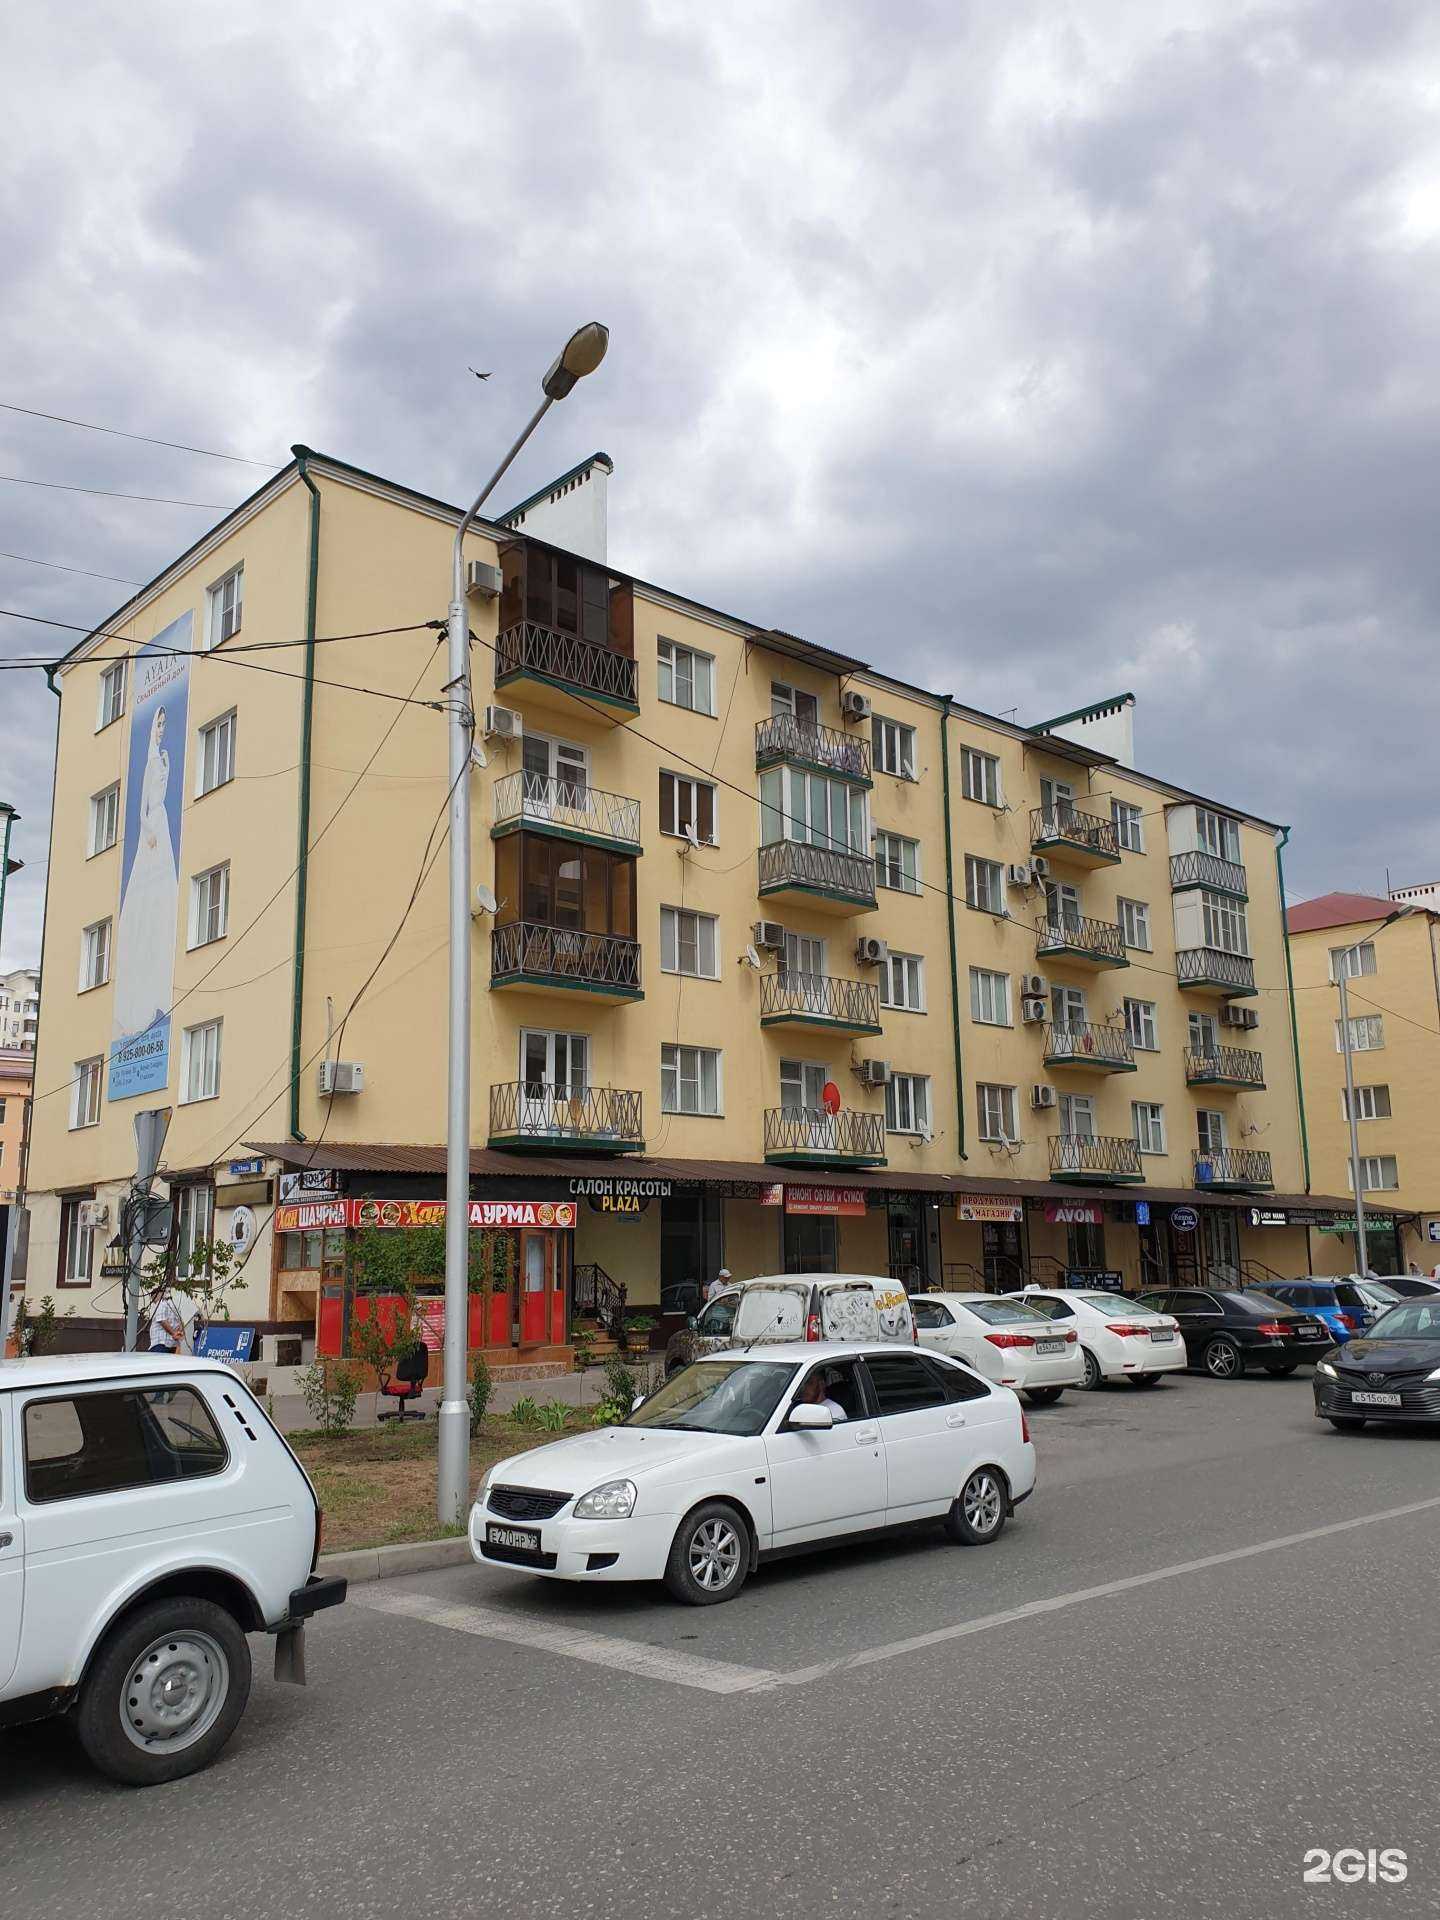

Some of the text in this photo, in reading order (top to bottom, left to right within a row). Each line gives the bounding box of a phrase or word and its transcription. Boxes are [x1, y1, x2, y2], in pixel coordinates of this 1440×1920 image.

[569, 1178, 672, 1196] САЛОН КРАСОТЫ
[787, 1187, 813, 1201] РЕМОНТ
[814, 1189, 835, 1202] ОБУВИ
[843, 1190, 865, 1203] СУМОК
[602, 1195, 640, 1211] PLAZA
[299, 1203, 345, 1227] ШАУРМА
[469, 1204, 536, 1225] АУРМА
[975, 1208, 1010, 1217] МАГАЗИН
[1054, 1208, 1095, 1223] AVON
[207, 1349, 234, 1358] РЕМОНТ
[491, 1530, 527, 1549] Е270НР
